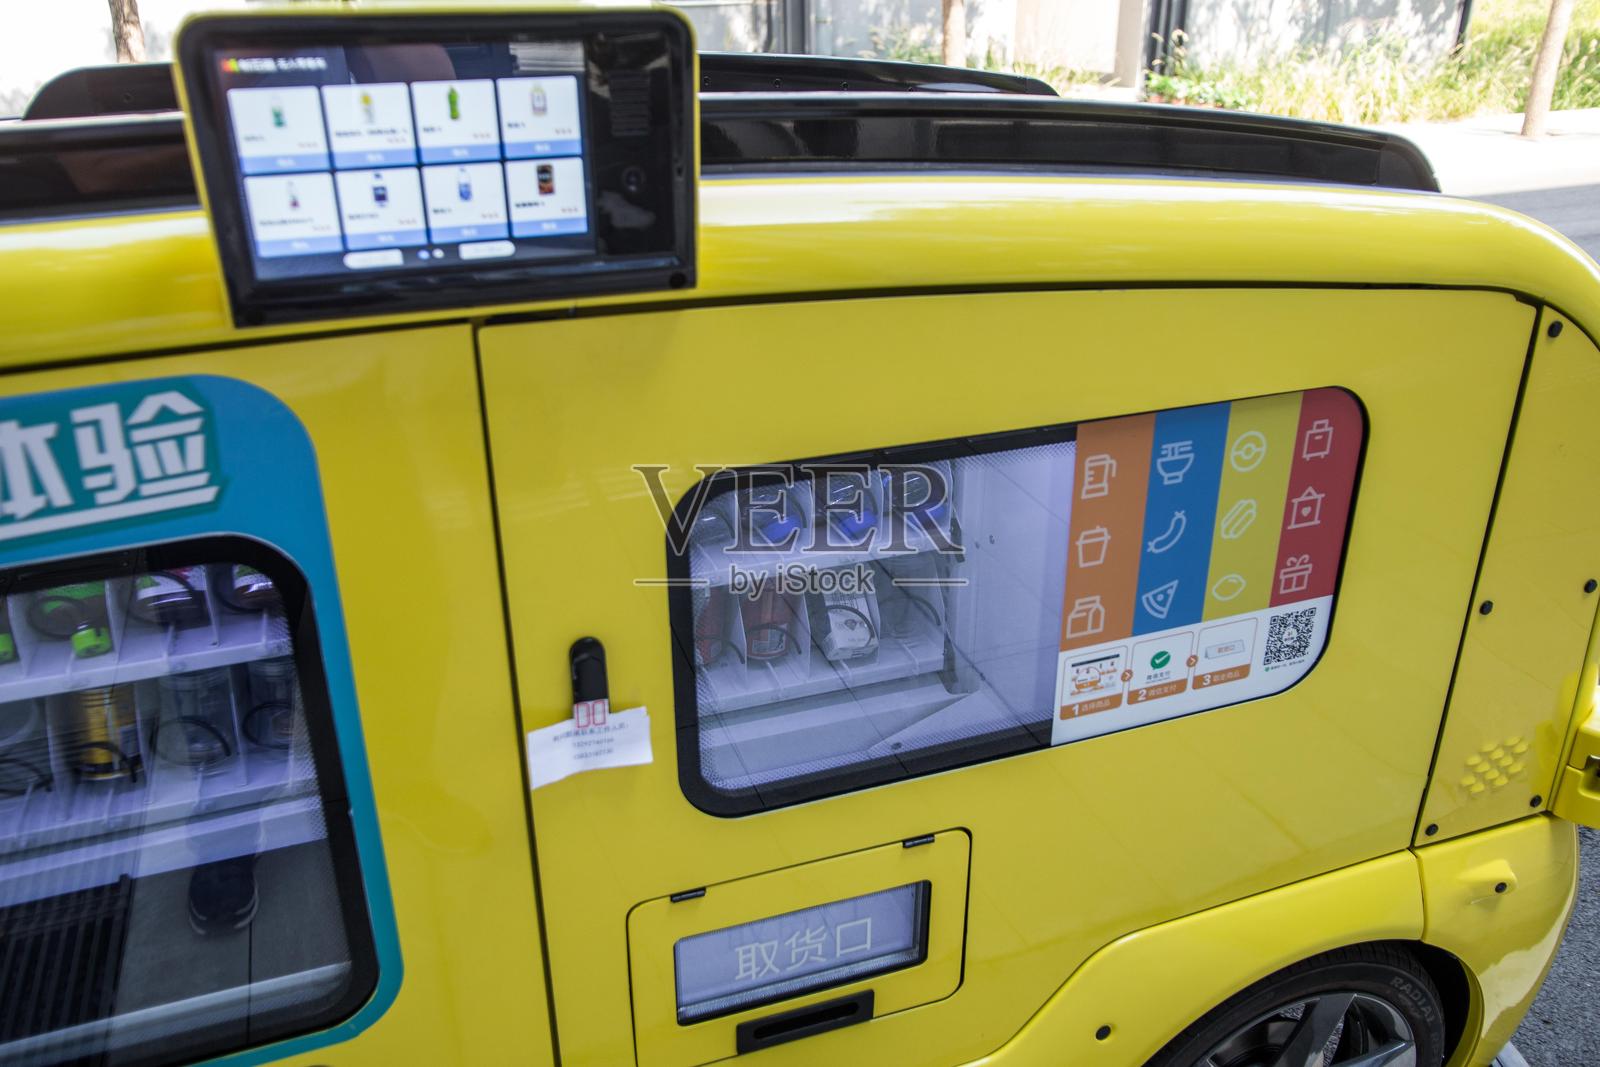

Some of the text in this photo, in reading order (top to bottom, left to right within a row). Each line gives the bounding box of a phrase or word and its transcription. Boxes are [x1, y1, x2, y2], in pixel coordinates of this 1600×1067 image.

[1202, 674, 1211, 686] 3
[1138, 689, 1148, 701] 2
[1072, 704, 1080, 716] 1
[736, 918, 872, 981] 取货口
[1391, 978, 1435, 1022] RADIAL
